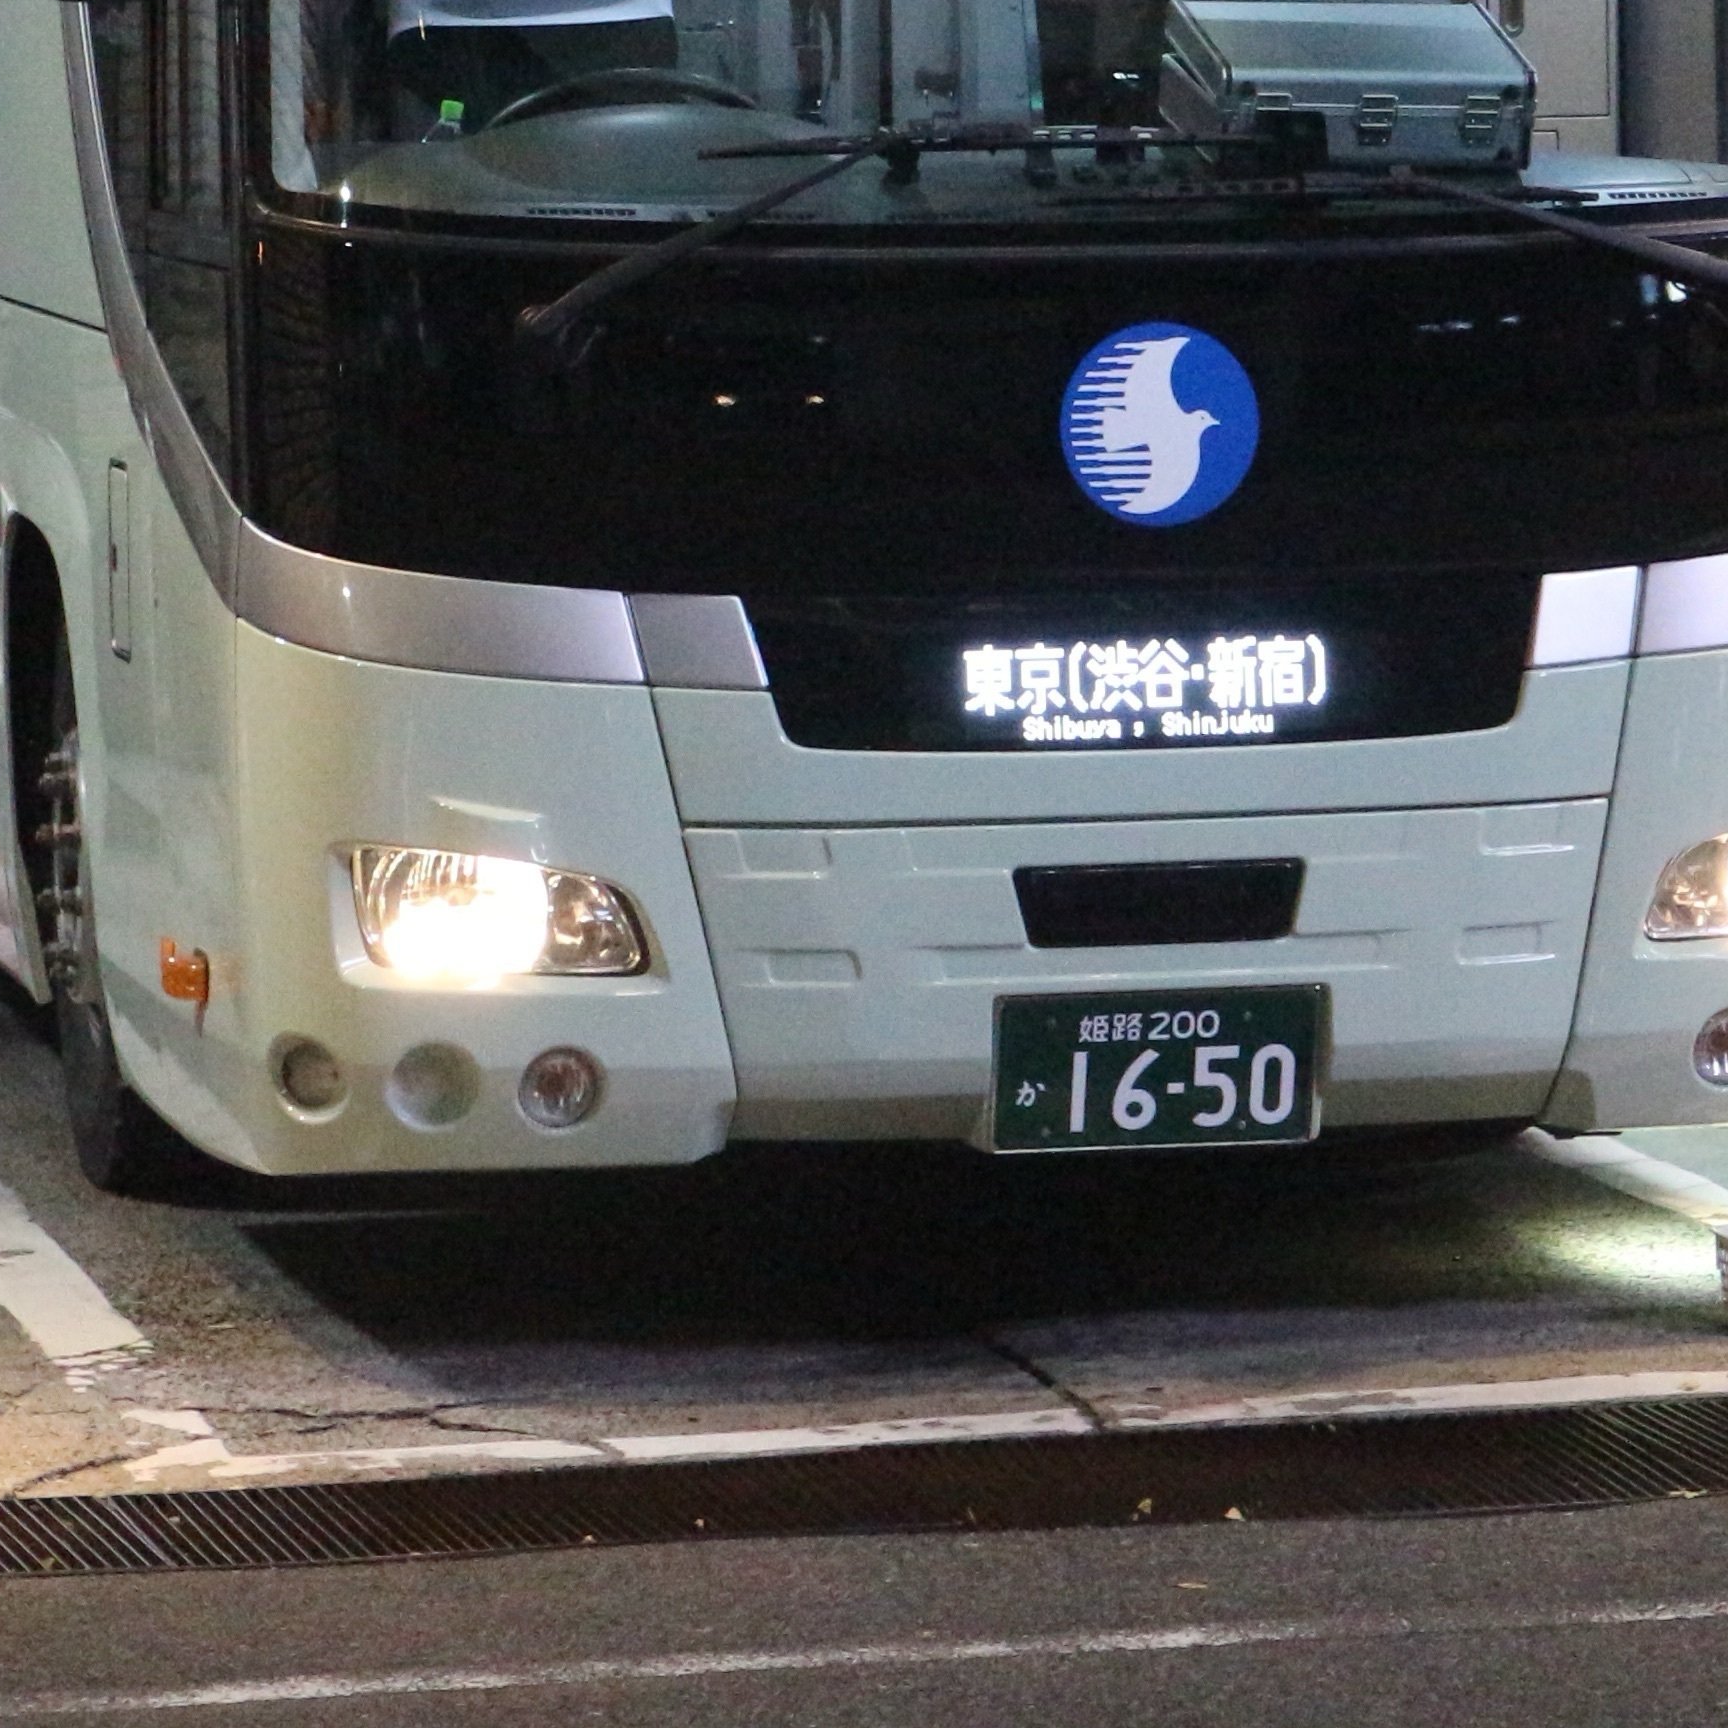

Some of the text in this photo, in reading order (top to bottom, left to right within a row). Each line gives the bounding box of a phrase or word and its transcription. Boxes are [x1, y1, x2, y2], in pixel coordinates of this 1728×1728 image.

[1161, 708, 1275, 737] Shinjuku
[1078, 1010, 1221, 1043] 姫路 200
[1015, 1043, 1296, 1134] か 16-50
